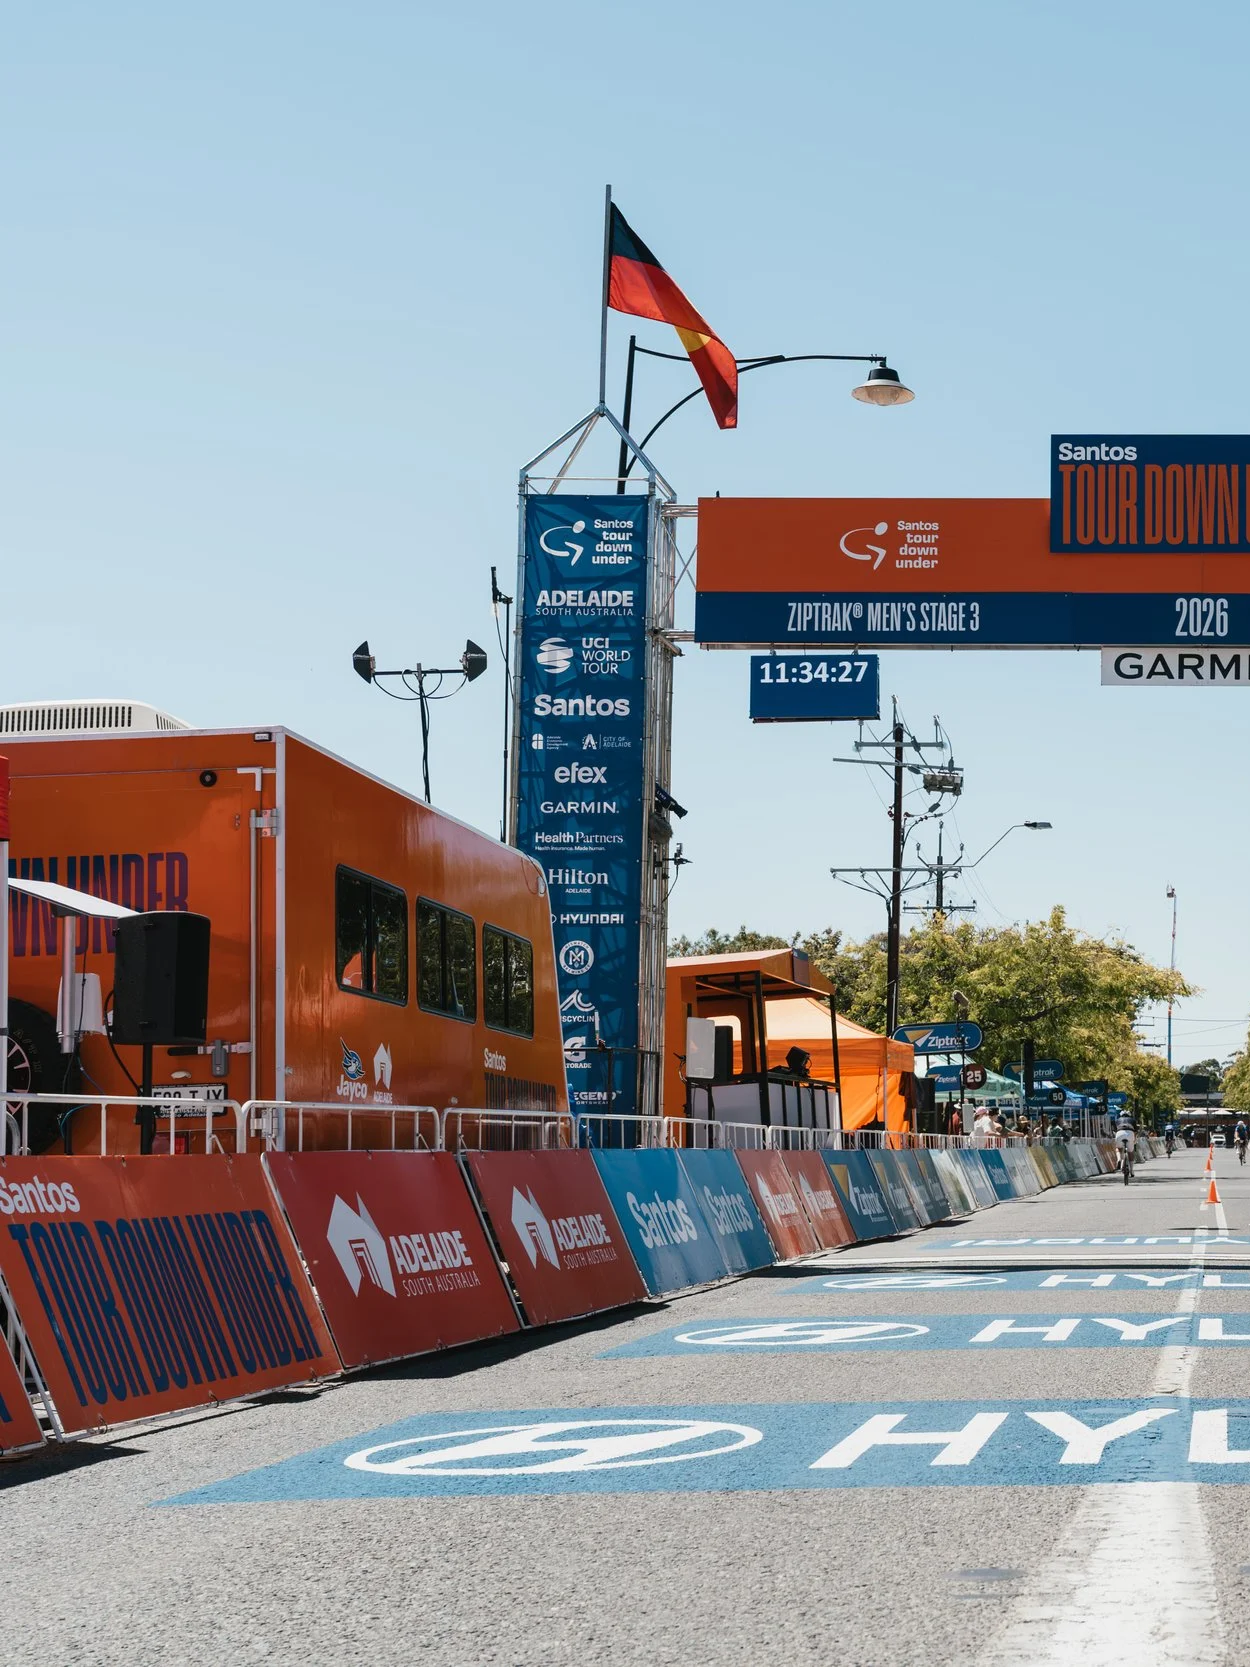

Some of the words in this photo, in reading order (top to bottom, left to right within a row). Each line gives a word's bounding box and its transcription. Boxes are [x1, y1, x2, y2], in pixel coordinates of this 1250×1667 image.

[1058, 442, 1138, 462] Santos
[1058, 463, 1138, 546] TOUR
[1144, 463, 1240, 546] DOWN
[594, 519, 633, 529] Santos
[897, 520, 939, 532] Santos
[602, 531, 633, 541] tour
[906, 532, 939, 544] tour
[595, 542, 632, 552] down
[899, 544, 938, 556] down
[592, 554, 632, 564] under
[895, 557, 938, 569] under
[536, 590, 634, 607] ADELAIDE
[536, 607, 571, 616] SOUTH
[576, 607, 634, 616] AUSTRALIA
[920, 602, 966, 632] STAGE
[970, 602, 980, 632] 3
[1175, 598, 1229, 637] 2026
[582, 638, 609, 649] UCI
[582, 650, 631, 661] WORLD
[582, 663, 618, 674] TOUR
[760, 660, 868, 684] 11:34:27
[534, 694, 630, 717] Santos
[554, 762, 607, 784] efex
[535, 832, 574, 843] Health
[576, 832, 624, 843] Partners
[548, 869, 608, 885] Hilton
[560, 914, 624, 924] HYUNDAI
[484, 1048, 506, 1071] Santos
[966, 1071, 981, 1082] 25
[1033, 1068, 1055, 1078] ptrak
[337, 1074, 368, 1102] Jayco
[573, 1091, 616, 1100] EGEN
[0, 1175, 80, 1215] Santos
[704, 1185, 753, 1236] Santos
[626, 1191, 697, 1249] Santos
[551, 1213, 611, 1251] ADELAIDE
[389, 1230, 473, 1274] ADELAIDE
[563, 1252, 585, 1269] SOUTH
[587, 1248, 618, 1266] AUSTRALIA
[403, 1276, 435, 1297] SOUTH
[437, 1270, 481, 1292] AUSTRALIA
[8, 1221, 150, 1406] TOUR
[94, 1215, 238, 1392] DOWN
[186, 1209, 322, 1375] UNDER
